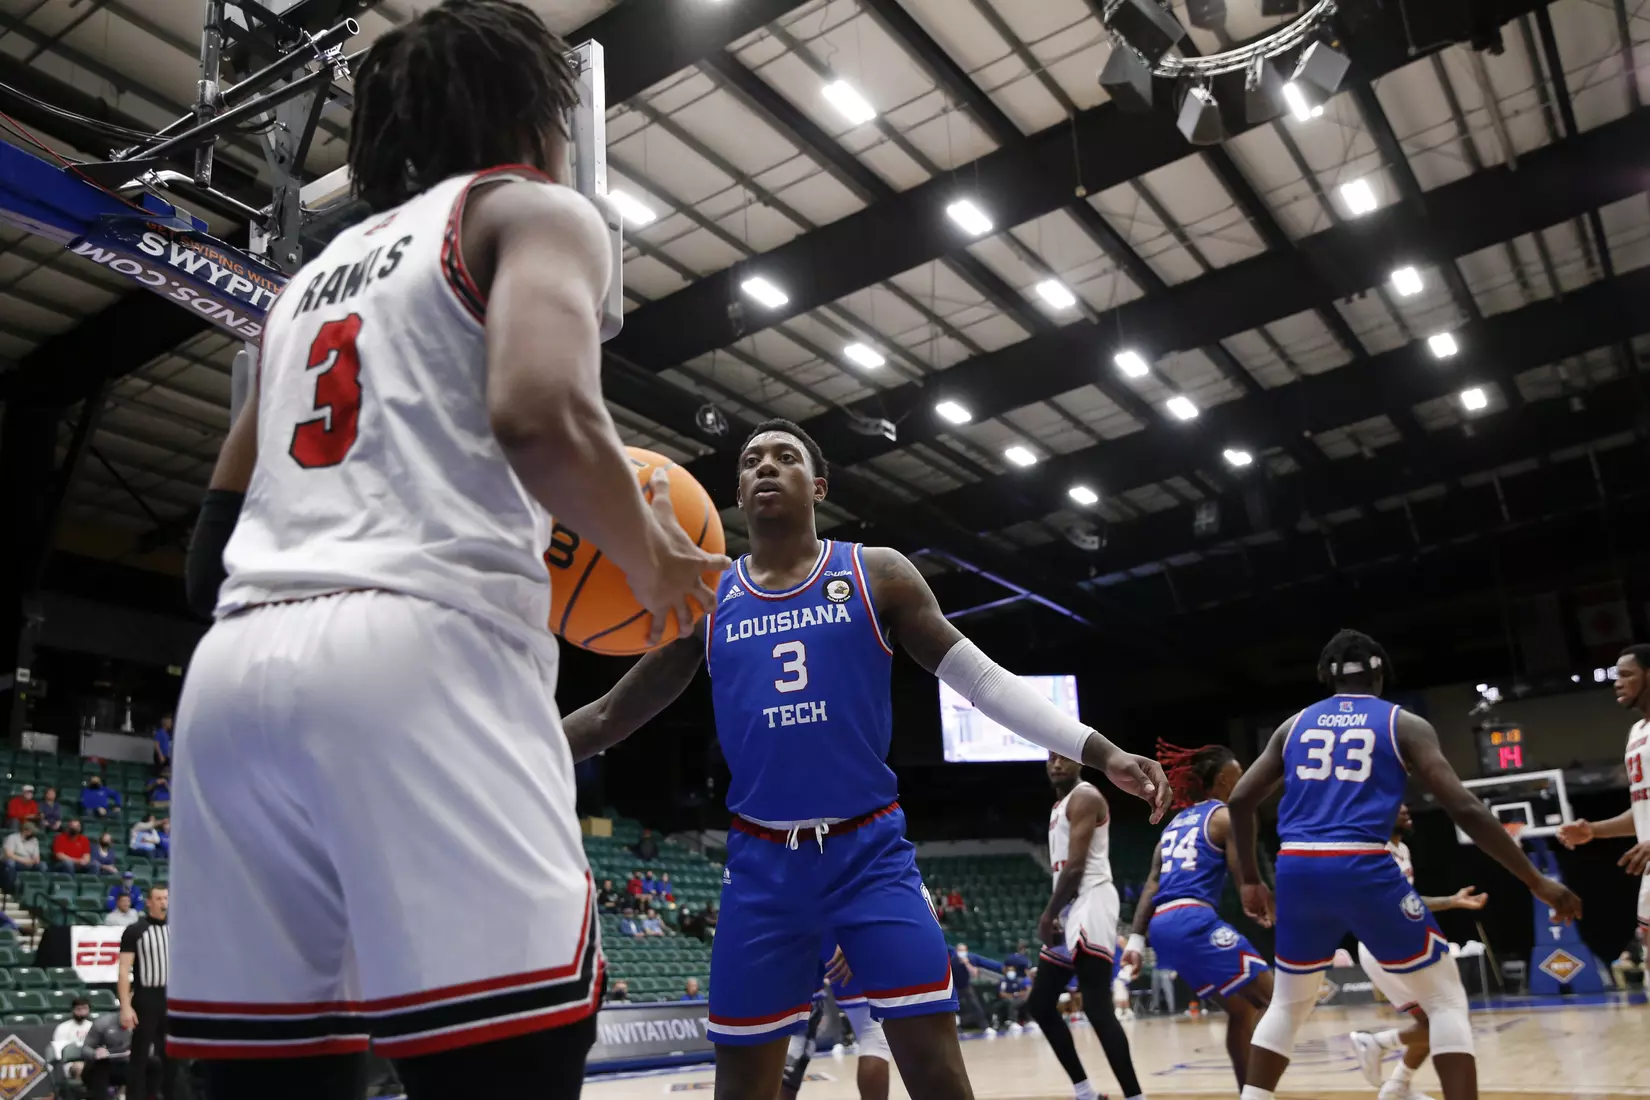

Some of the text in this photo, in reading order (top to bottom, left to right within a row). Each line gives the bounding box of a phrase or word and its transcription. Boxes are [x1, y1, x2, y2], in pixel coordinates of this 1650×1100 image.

[136, 231, 276, 311] SWYPIT
[180, 235, 245, 275] SWIPING
[247, 267, 286, 294] WITH
[289, 312, 363, 469] 3
[726, 604, 852, 643] LOUISIANA
[772, 640, 809, 693] 3
[763, 701, 828, 728] TECH
[1317, 714, 1368, 727] GORDON
[1296, 728, 1376, 782] 33
[1160, 827, 1200, 873] 24
[600, 1018, 699, 1045] INVITATION
